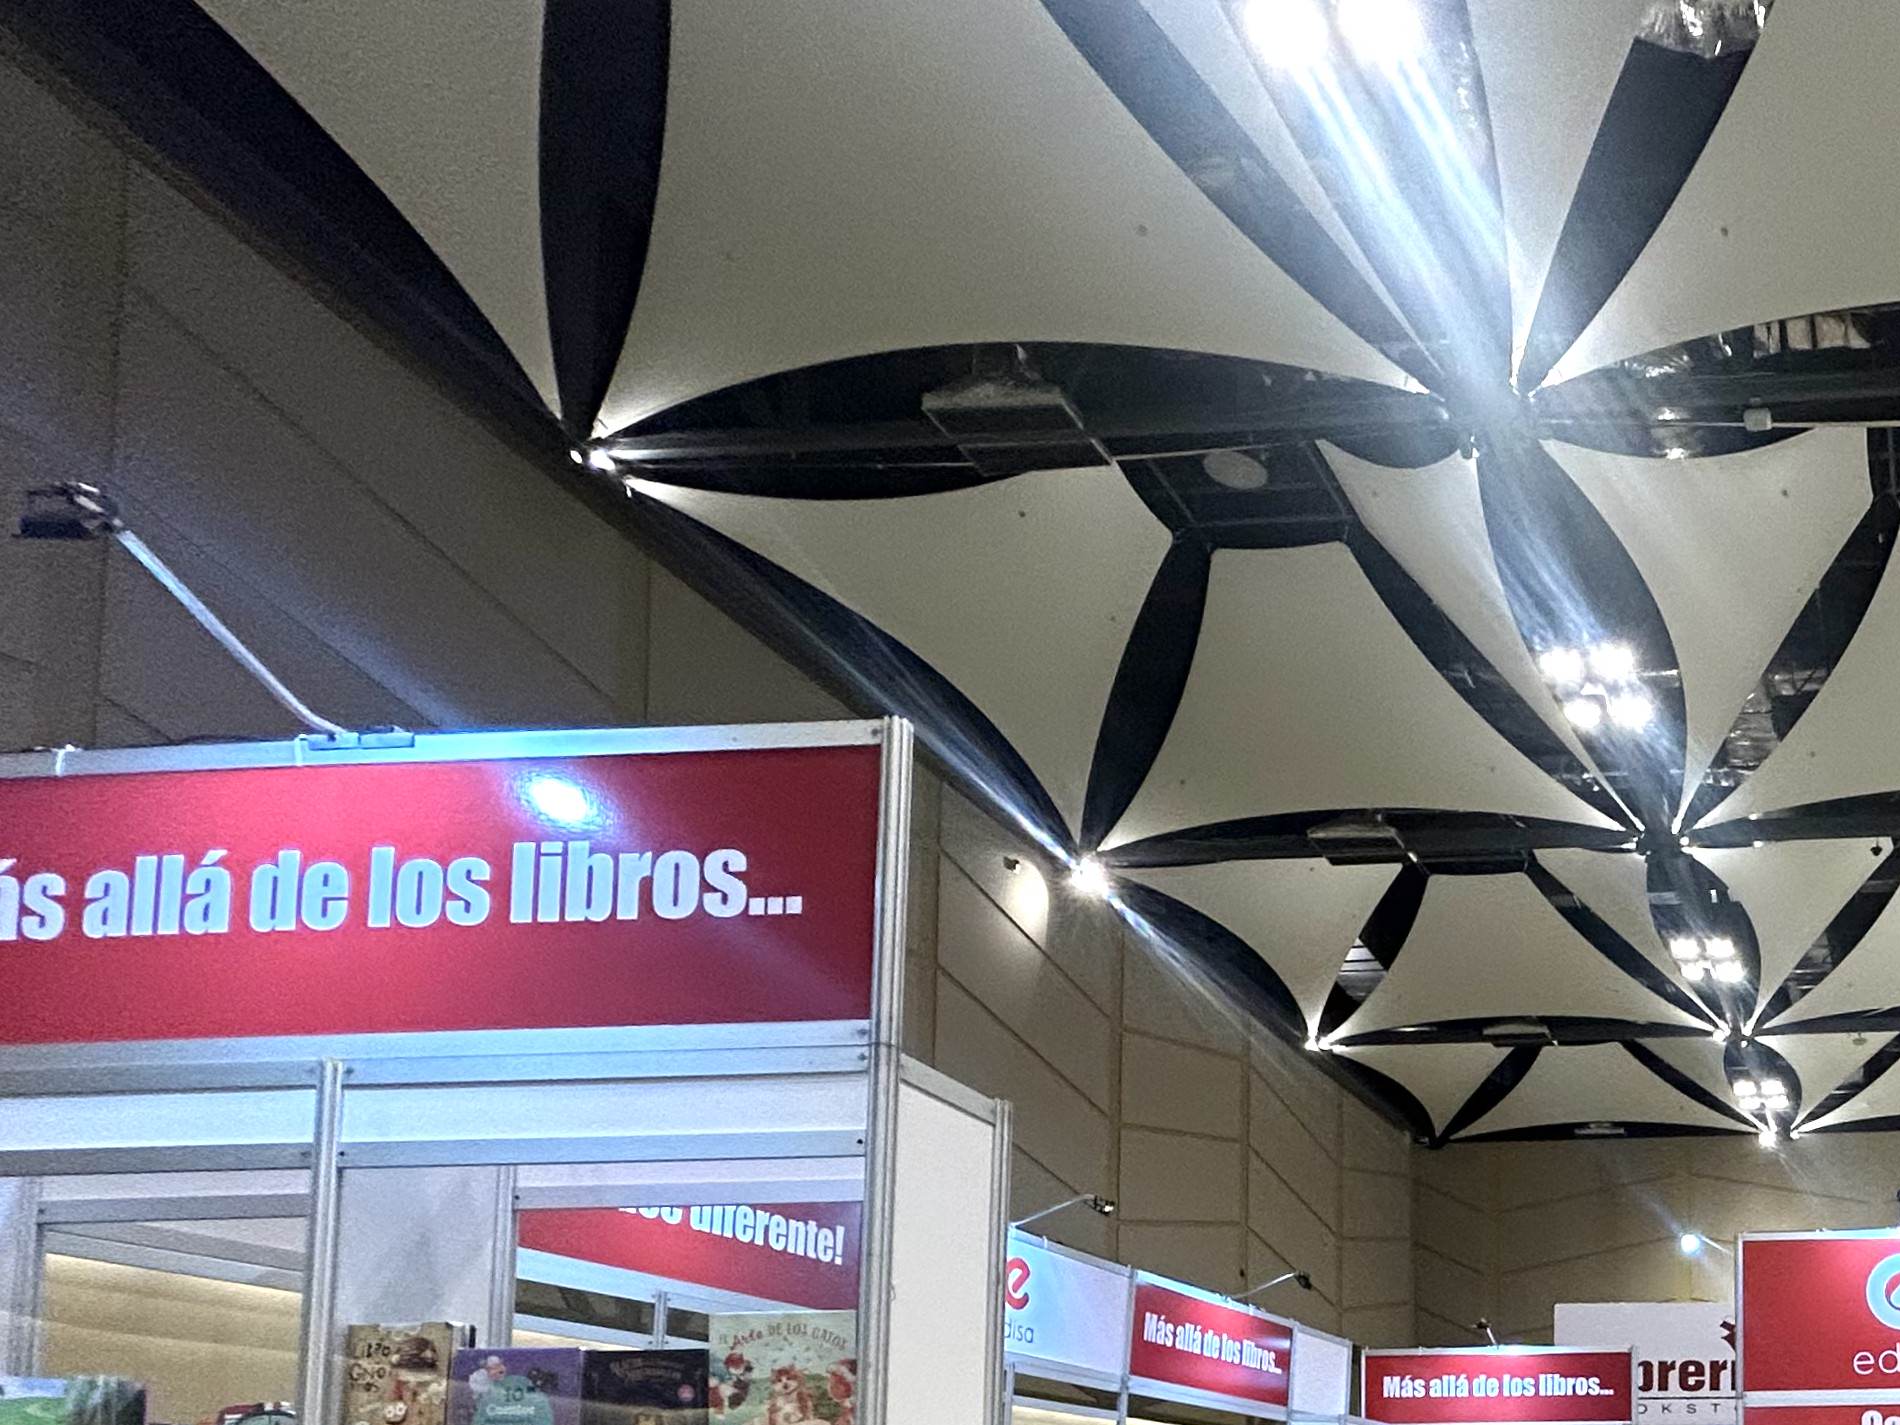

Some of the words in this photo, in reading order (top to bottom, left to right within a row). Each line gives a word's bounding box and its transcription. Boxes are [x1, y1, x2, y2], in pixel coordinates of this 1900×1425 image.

[82, 849, 231, 938] allá
[250, 848, 350, 932] de
[367, 846, 490, 929] los
[510, 840, 803, 924] libros...
[1144, 1312, 1173, 1349] Más
[1176, 1321, 1202, 1355] allá
[1203, 1329, 1221, 1358] de
[1222, 1333, 1240, 1365] los
[1383, 1374, 1425, 1399] Más
[1429, 1373, 1468, 1398] allá
[1473, 1374, 1498, 1398] de
[1503, 1373, 1535, 1397] los
[1539, 1372, 1613, 1397] libros...
